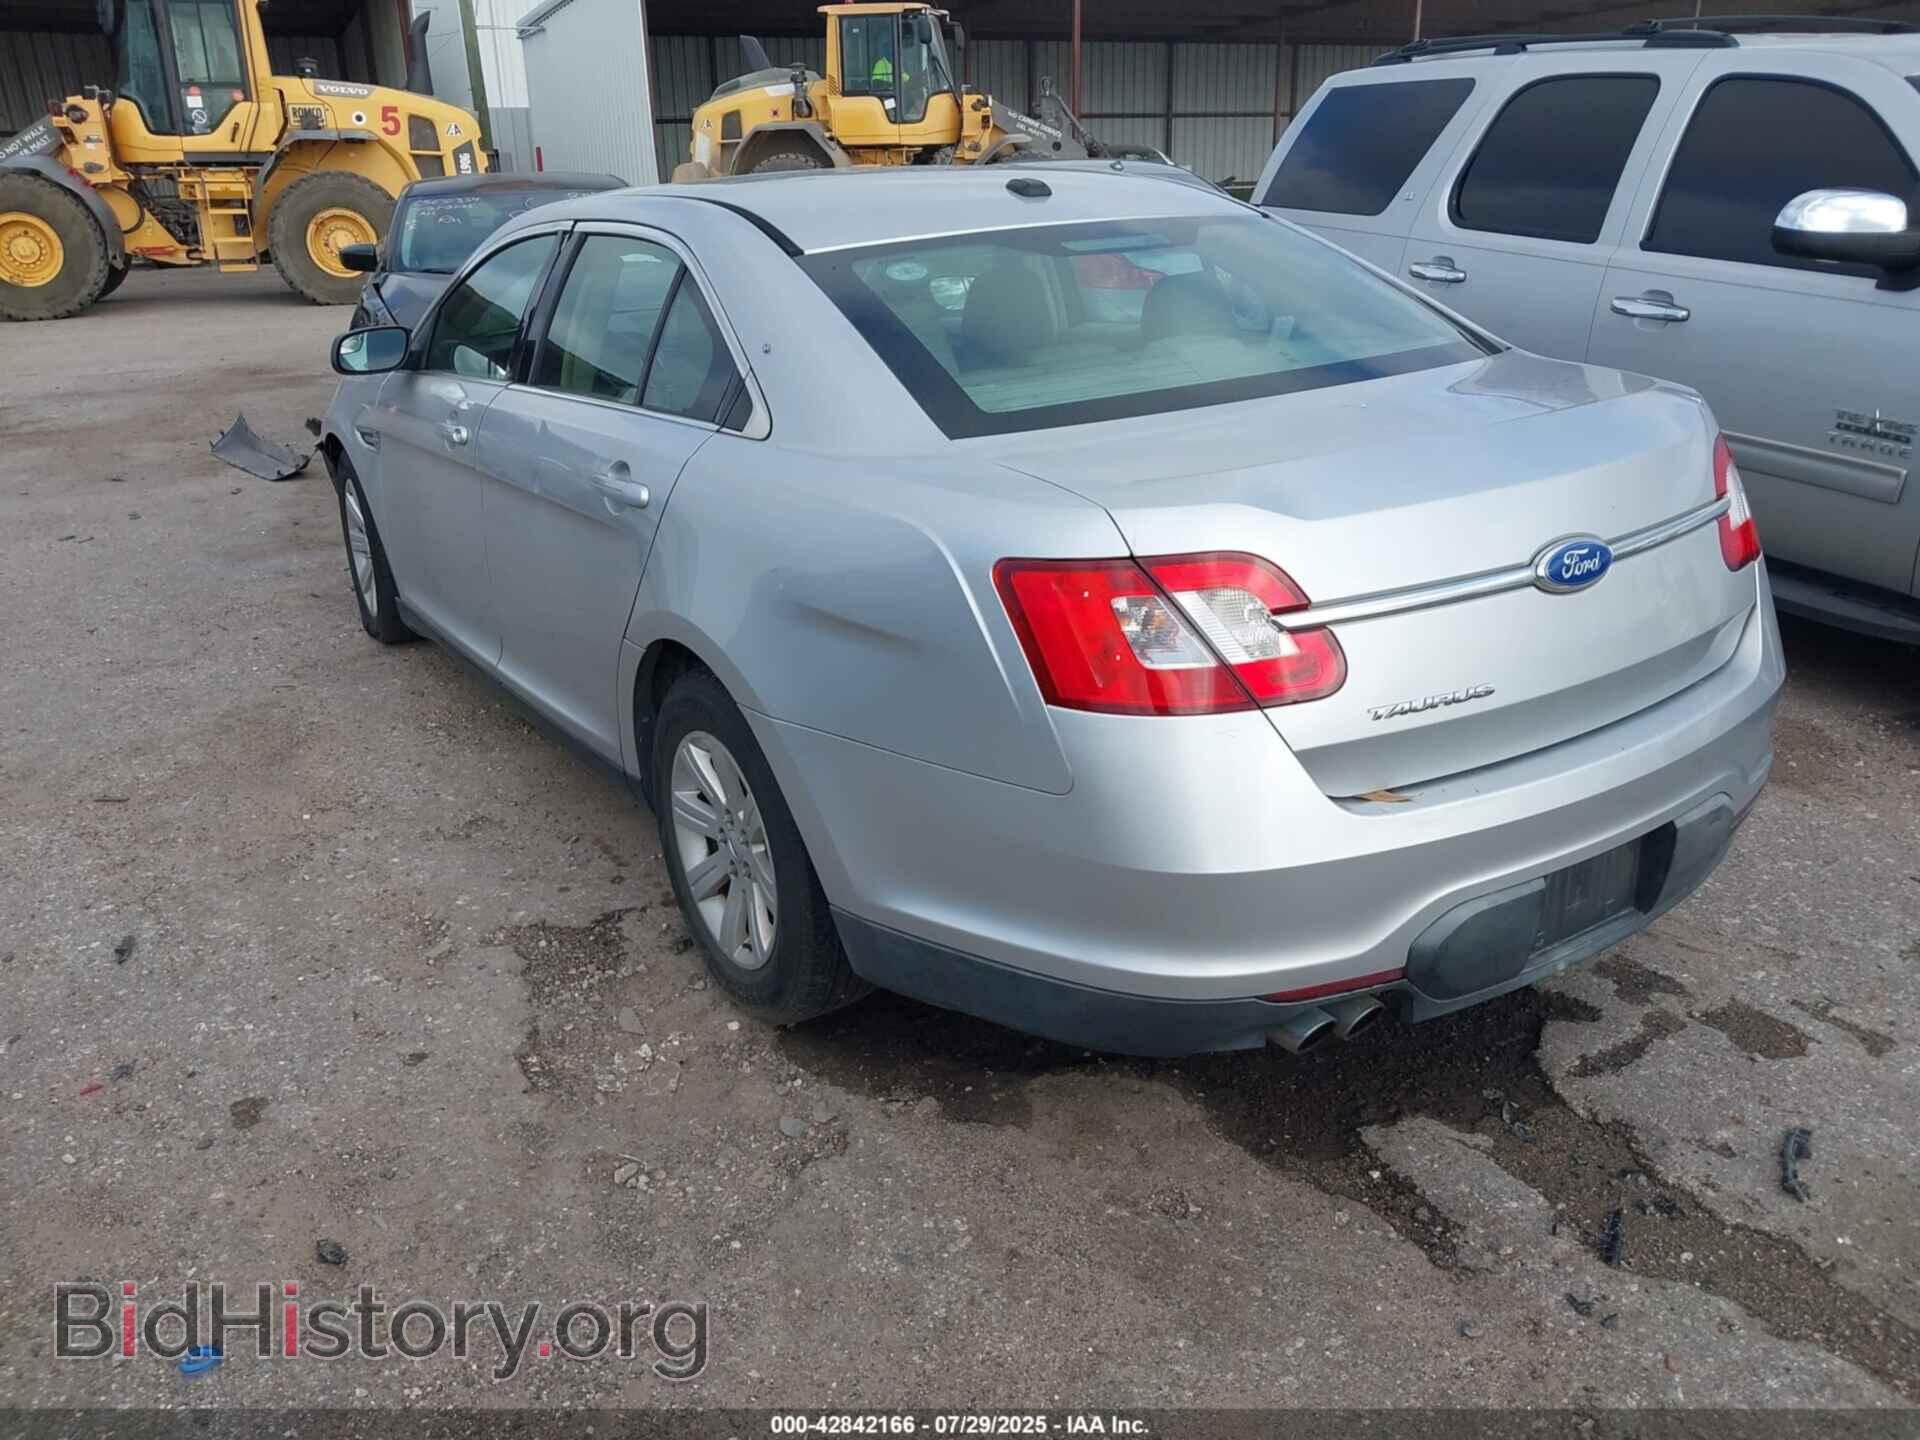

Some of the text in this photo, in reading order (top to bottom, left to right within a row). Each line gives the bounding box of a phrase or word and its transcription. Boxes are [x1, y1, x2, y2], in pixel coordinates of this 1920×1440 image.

[318, 84, 369, 95] VOLVO
[22, 125, 47, 143] WALK
[381, 105, 401, 136] 5
[1561, 548, 1601, 579] Ford
[1366, 683, 1496, 721] TAURUS
